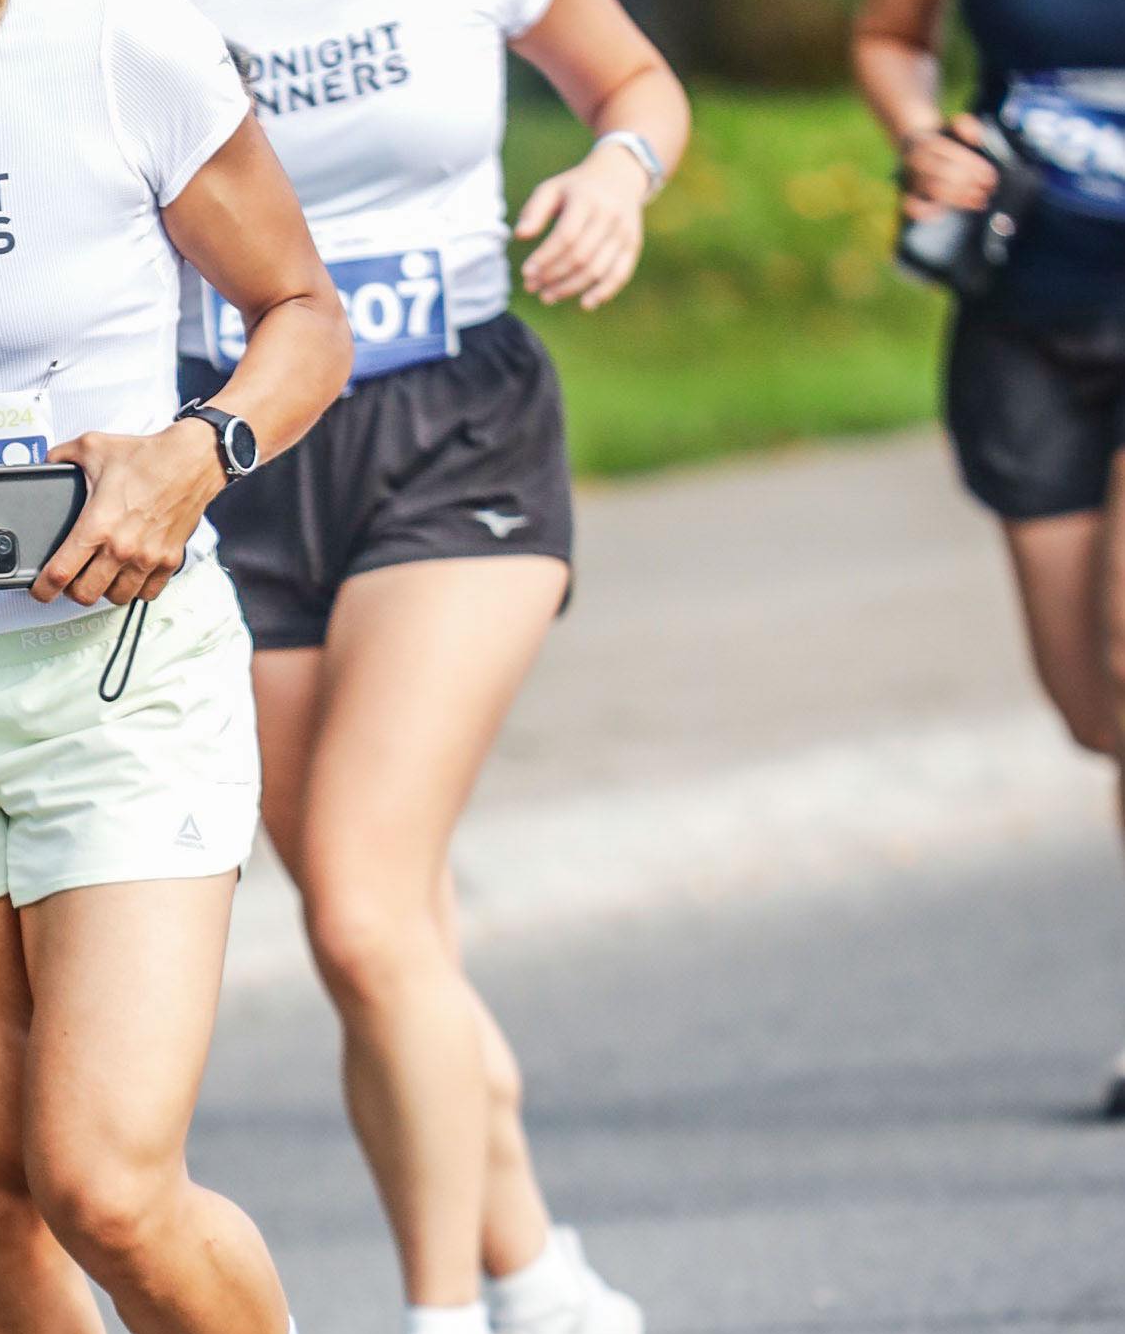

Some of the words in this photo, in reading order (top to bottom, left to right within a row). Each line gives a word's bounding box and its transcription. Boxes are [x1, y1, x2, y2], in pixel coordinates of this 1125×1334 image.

[244, 21, 400, 83] DNIGHT
[252, 54, 410, 116] NNERS
[19, 610, 115, 651] Reebok
